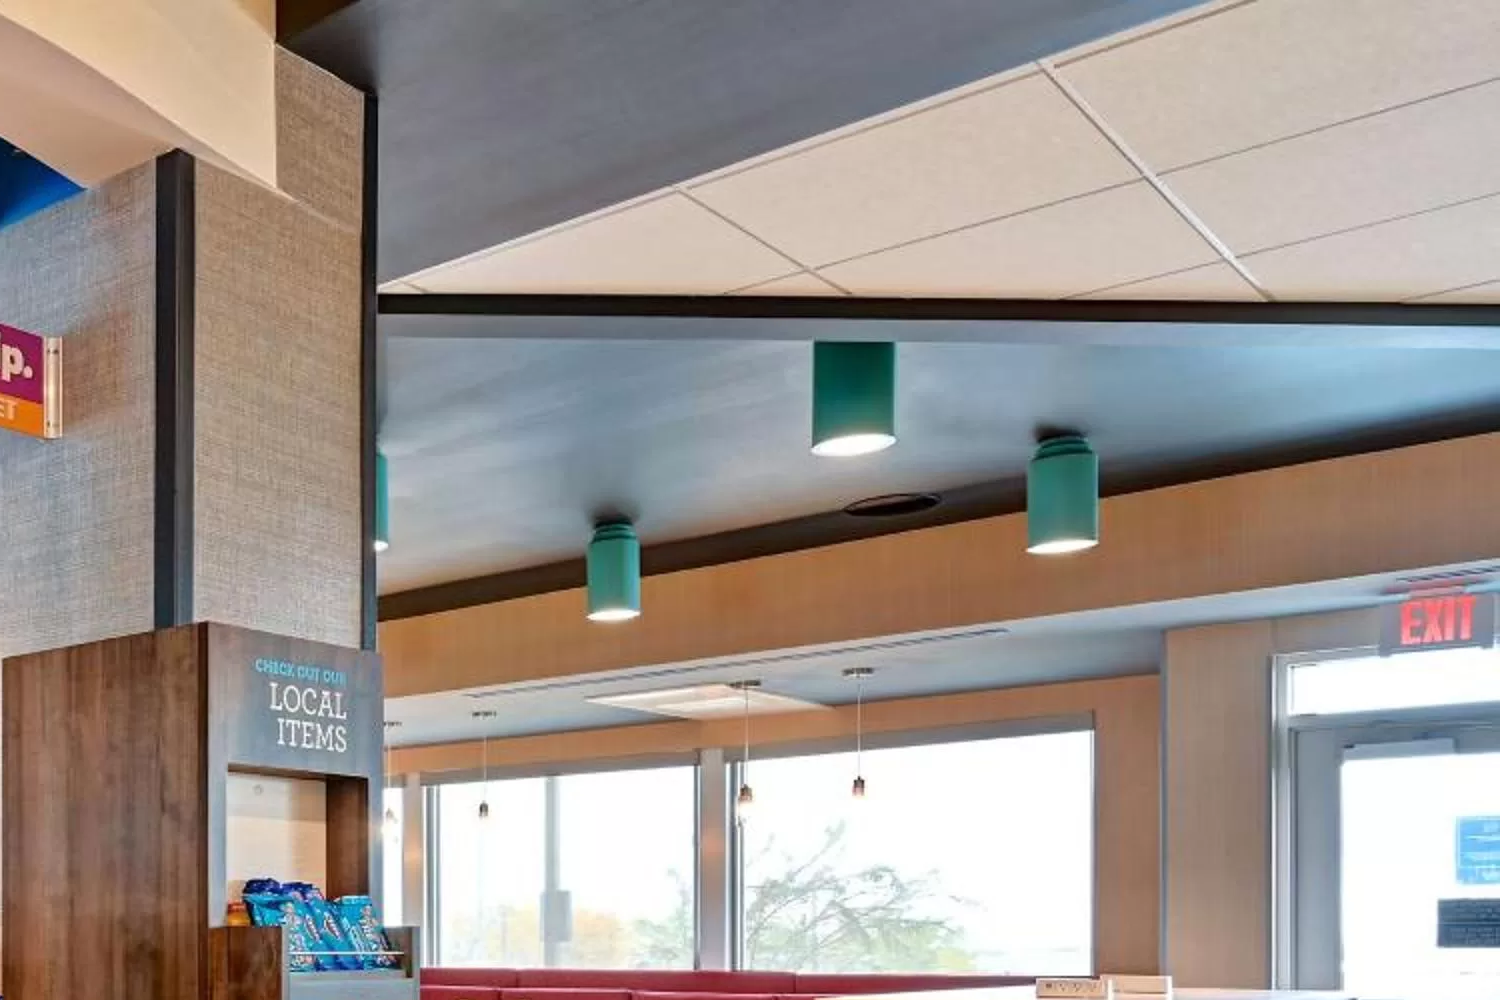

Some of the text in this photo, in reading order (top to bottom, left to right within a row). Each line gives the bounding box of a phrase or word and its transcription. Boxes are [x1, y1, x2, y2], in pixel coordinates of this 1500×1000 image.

[1401, 594, 1477, 645] EXIT
[255, 658, 295, 678] CHECK
[297, 666, 321, 682] OUT
[269, 681, 347, 720] LOCAL
[277, 718, 347, 753] ITEMS
